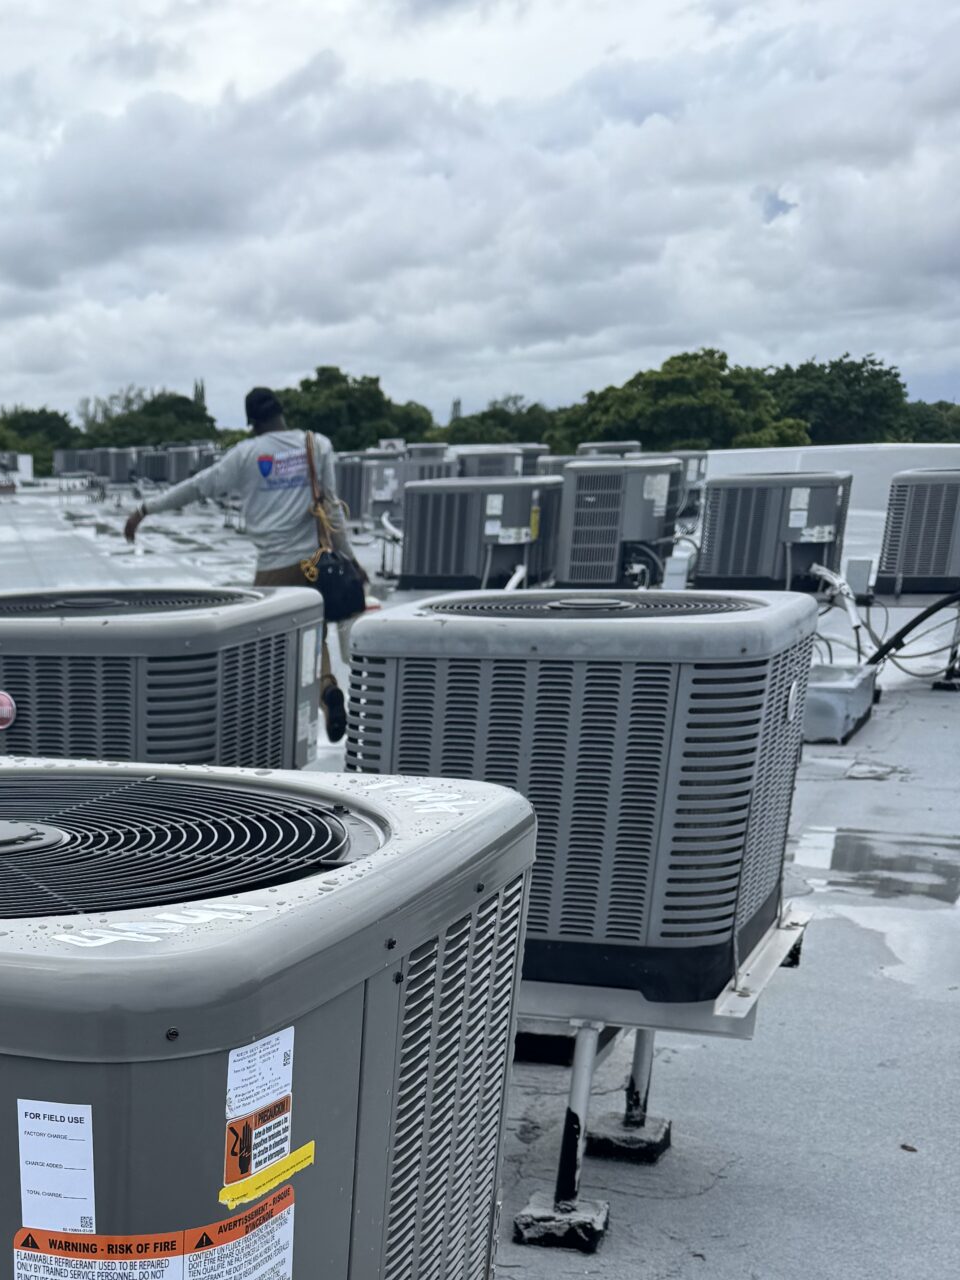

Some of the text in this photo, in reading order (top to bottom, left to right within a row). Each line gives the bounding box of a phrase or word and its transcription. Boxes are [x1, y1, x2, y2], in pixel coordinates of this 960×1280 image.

[24, 1111, 85, 1124] FOR FIELD USE
[24, 1130, 46, 1138] FACTORY
[25, 1160, 45, 1168] CHARGE
[218, 1202, 268, 1235] AVERTISSEMENT
[273, 1188, 290, 1206] RISQUE
[48, 1239, 97, 1253] WARNING
[107, 1244, 133, 1254] RISK
[136, 1243, 150, 1253] OF
[154, 1240, 176, 1252] FIRE
[17, 1251, 53, 1265] FLAMMABLE
[55, 1258, 96, 1269] REFRIGERANT
[119, 1262, 128, 1270] TO
[130, 1261, 137, 1270] BE
[139, 1259, 169, 1270] REPAIRED
[189, 1248, 216, 1262] CONTIENT
[17, 1262, 32, 1271] ONLY
[34, 1264, 42, 1273] BY
[43, 1266, 68, 1278] TRAINED
[70, 1270, 95, 1280] SERVICE
[139, 1271, 149, 1280] DO
[151, 1270, 164, 1279] NOT
[189, 1261, 202, 1270] DOIT
